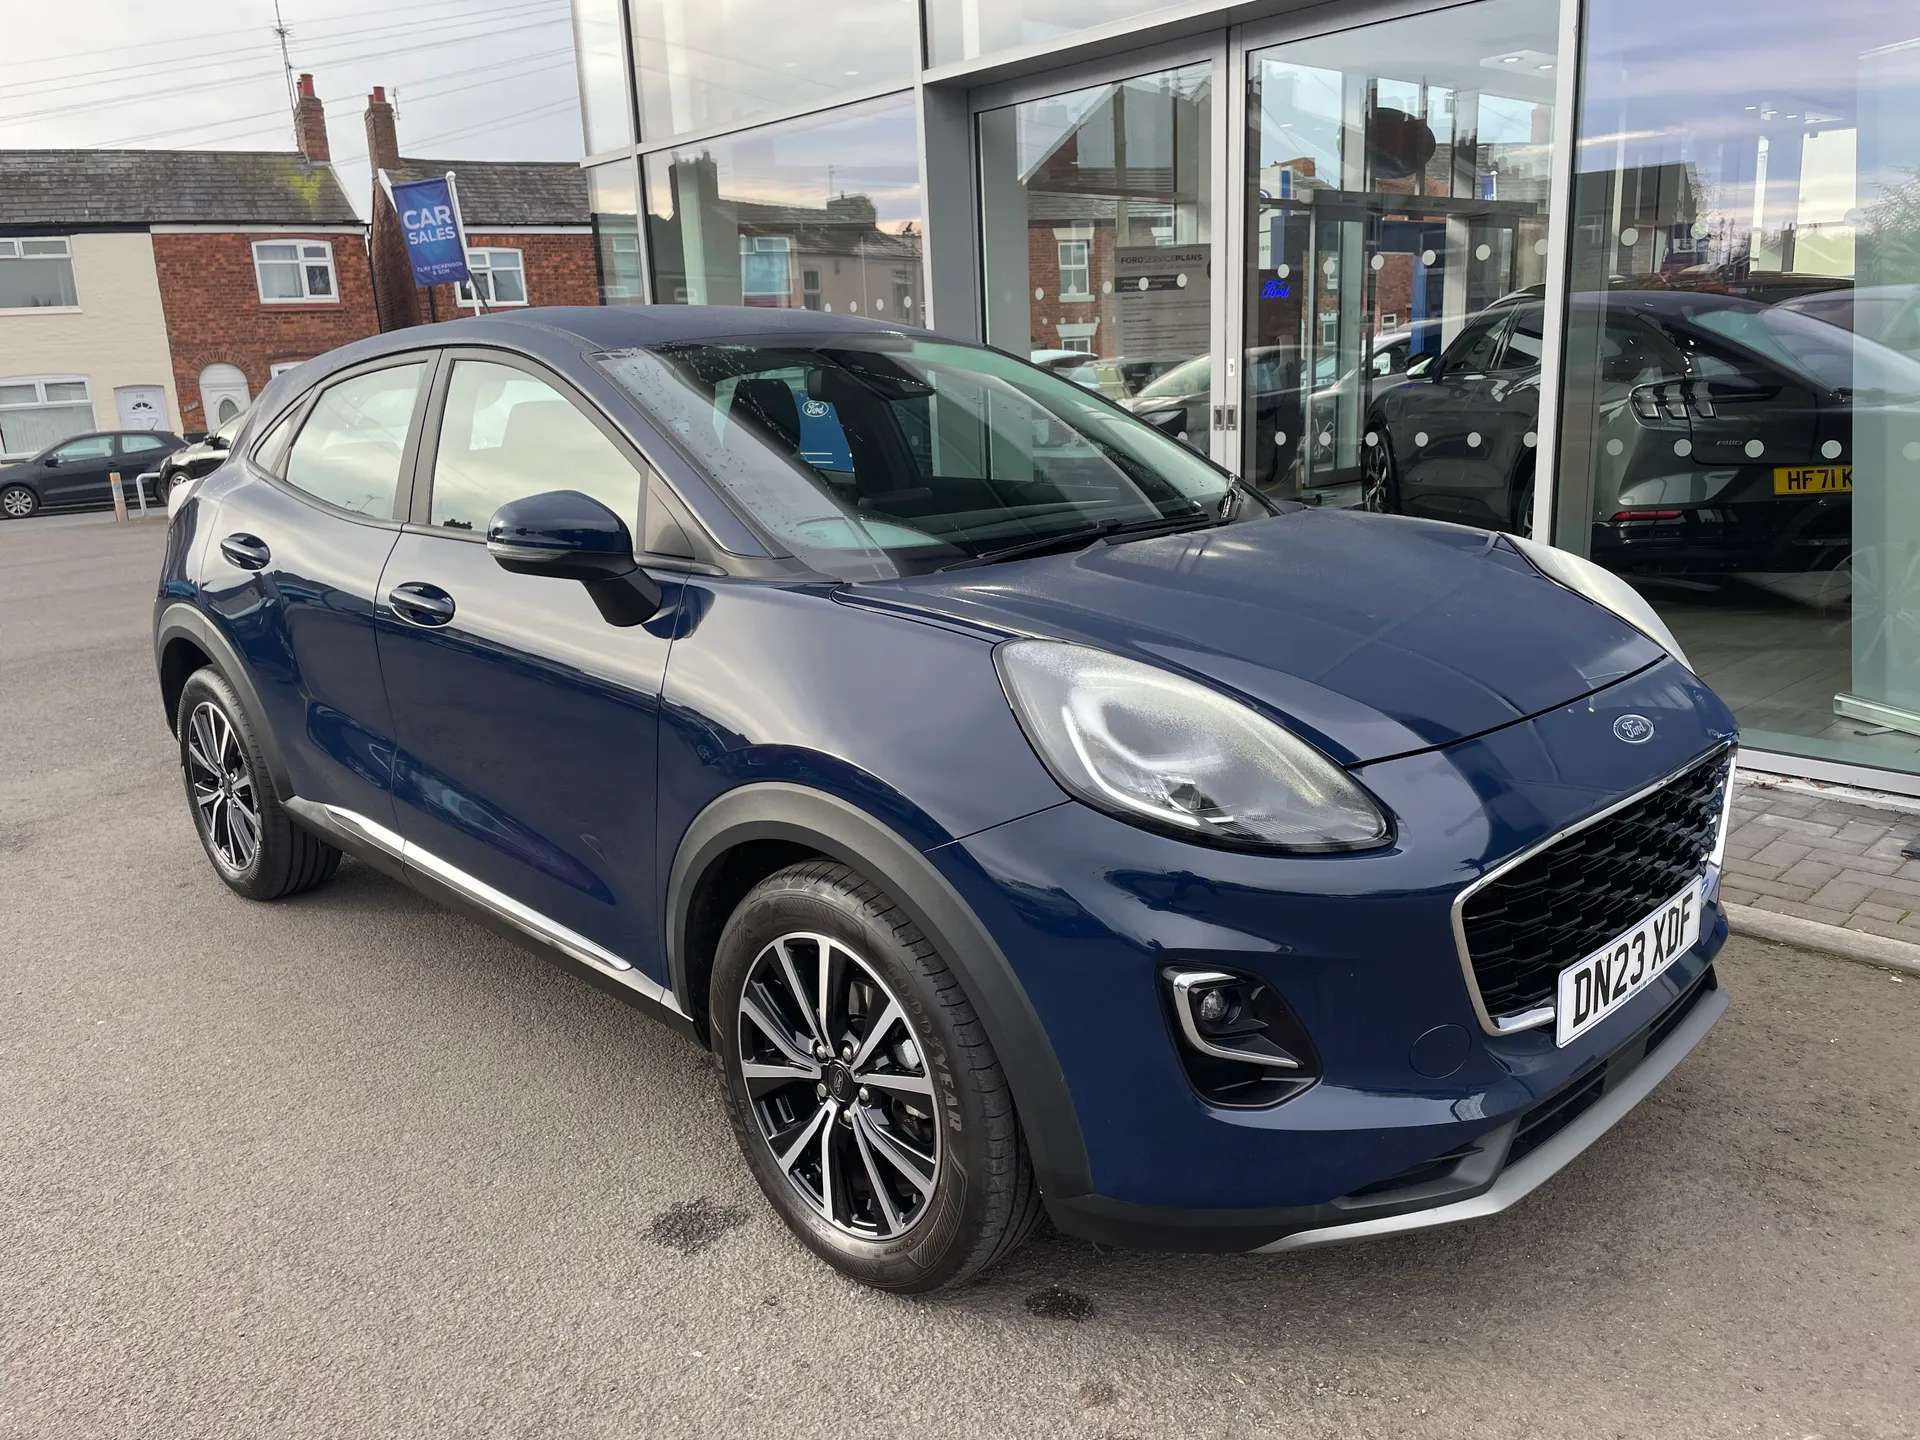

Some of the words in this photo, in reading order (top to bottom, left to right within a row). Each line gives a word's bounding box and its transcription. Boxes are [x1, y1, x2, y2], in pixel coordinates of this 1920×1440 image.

[402, 205, 452, 230] CAR
[408, 226, 456, 245] SALES
[1262, 279, 1290, 299] Ford
[1787, 468, 1836, 491] HF71
[1572, 929, 1647, 1030] DN23
[1650, 890, 1694, 971] XDF
